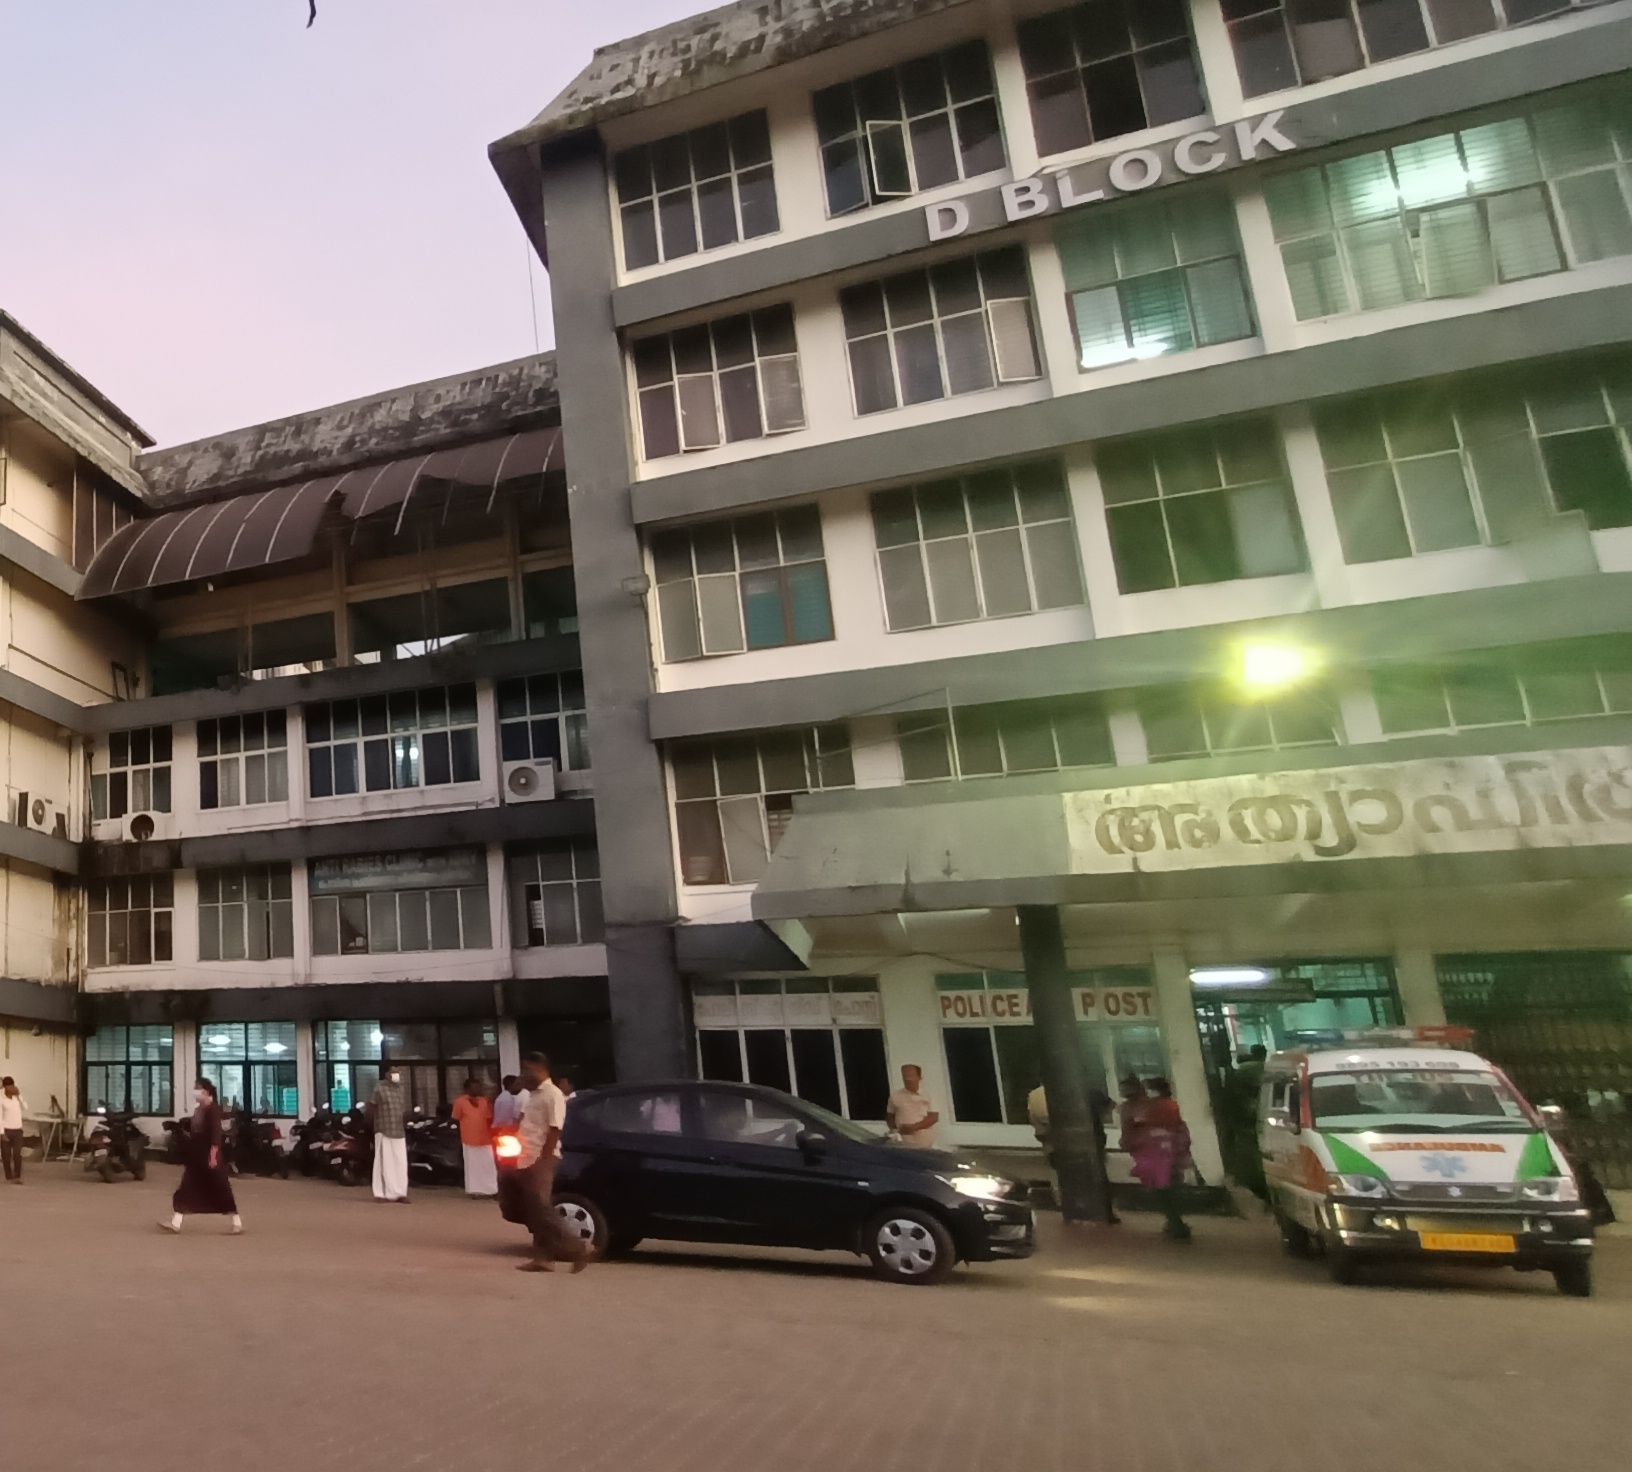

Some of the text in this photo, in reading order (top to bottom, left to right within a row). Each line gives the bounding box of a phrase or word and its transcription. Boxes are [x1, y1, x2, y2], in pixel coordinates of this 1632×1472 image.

[924, 110, 1298, 242] D BLOCK
[940, 993, 1022, 1019] POLICE
[1080, 991, 1152, 1018] POST
